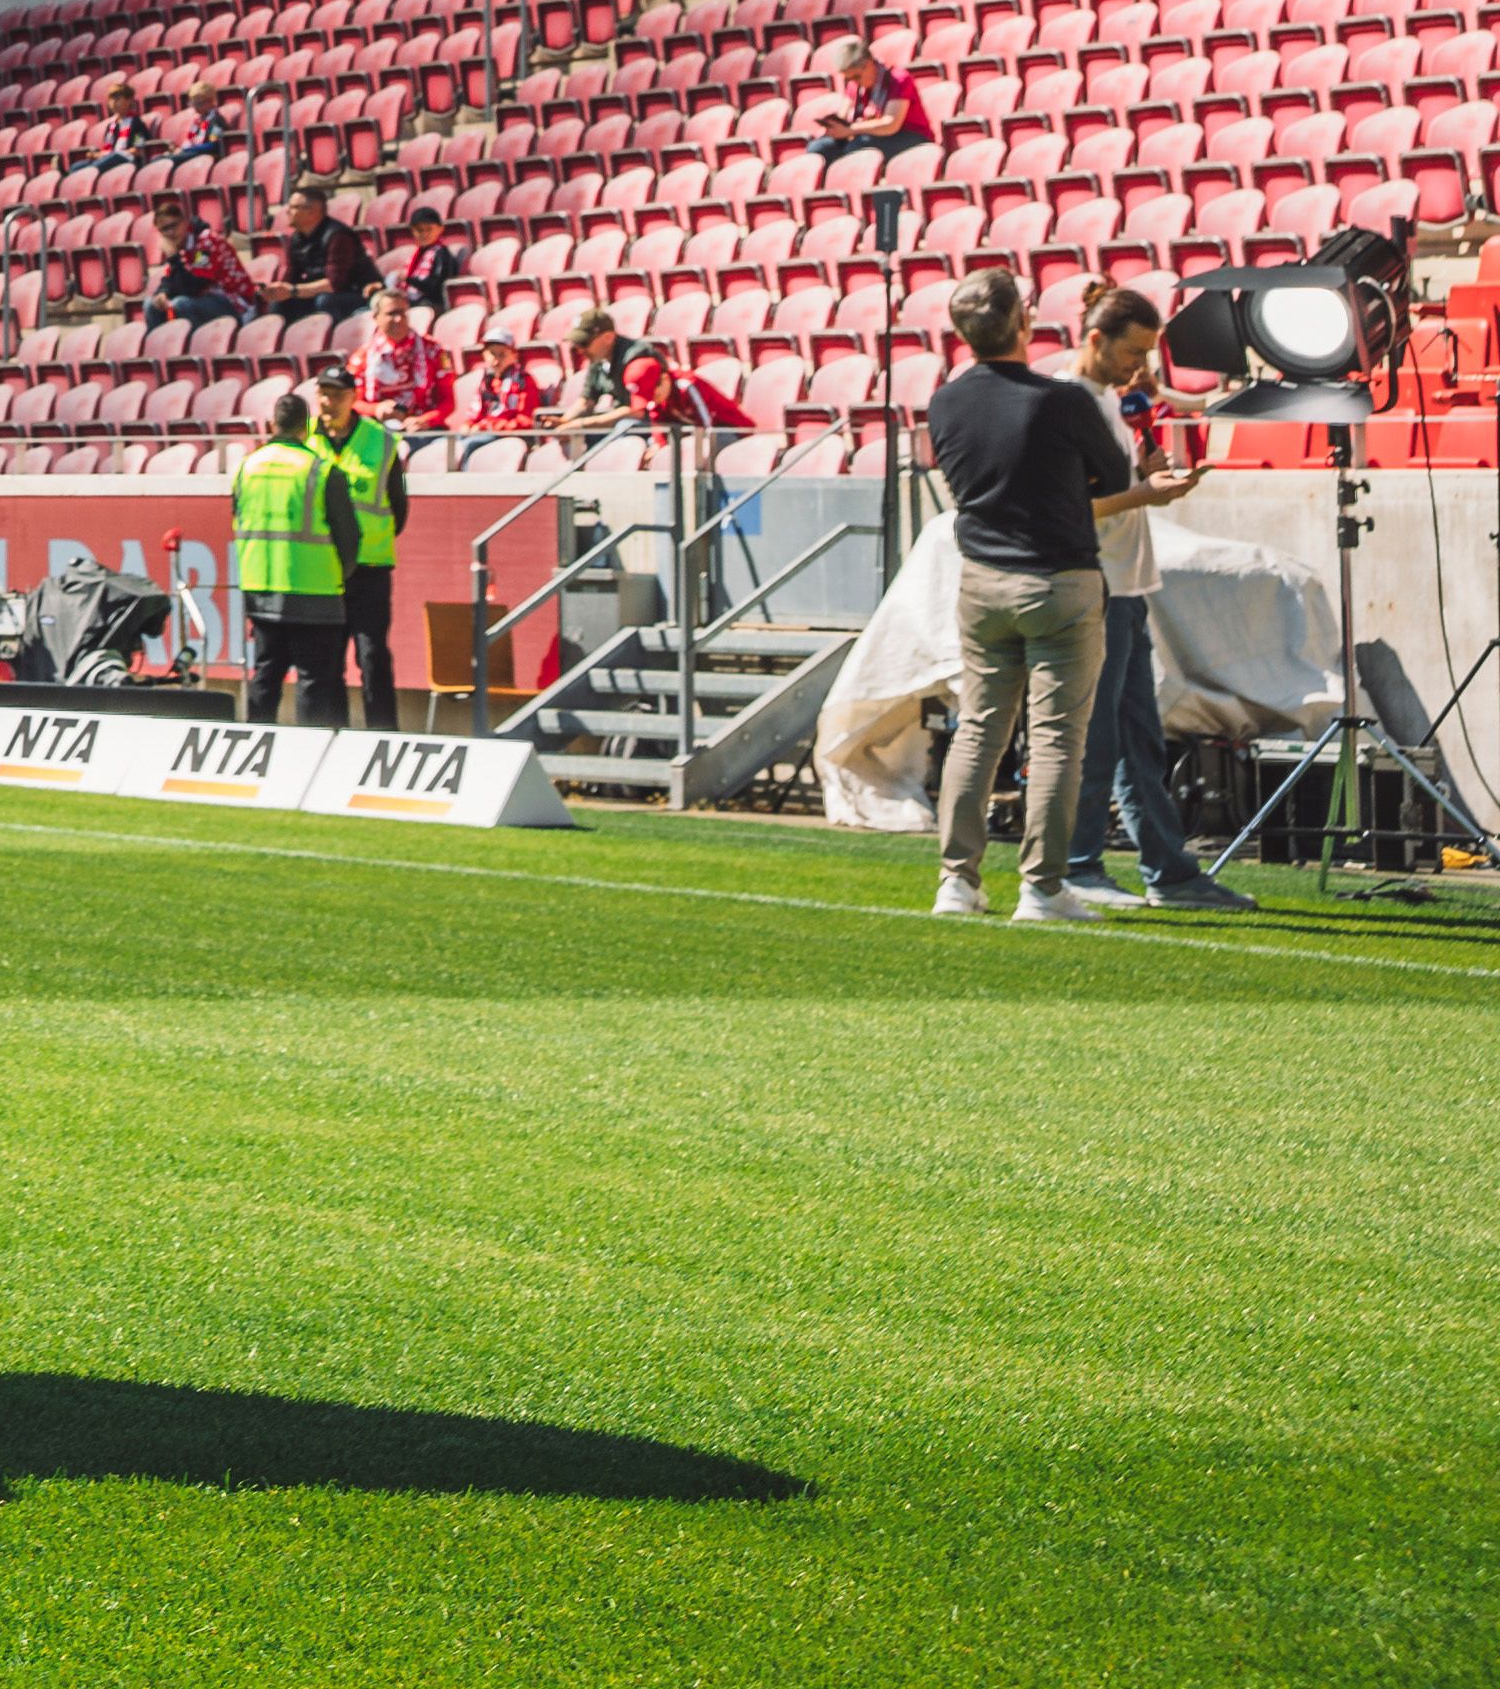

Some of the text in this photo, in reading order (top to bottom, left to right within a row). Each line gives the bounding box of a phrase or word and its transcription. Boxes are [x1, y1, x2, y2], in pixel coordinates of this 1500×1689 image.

[4, 715, 100, 764] NTA
[173, 727, 275, 779] NTA
[358, 740, 468, 795] NTA
